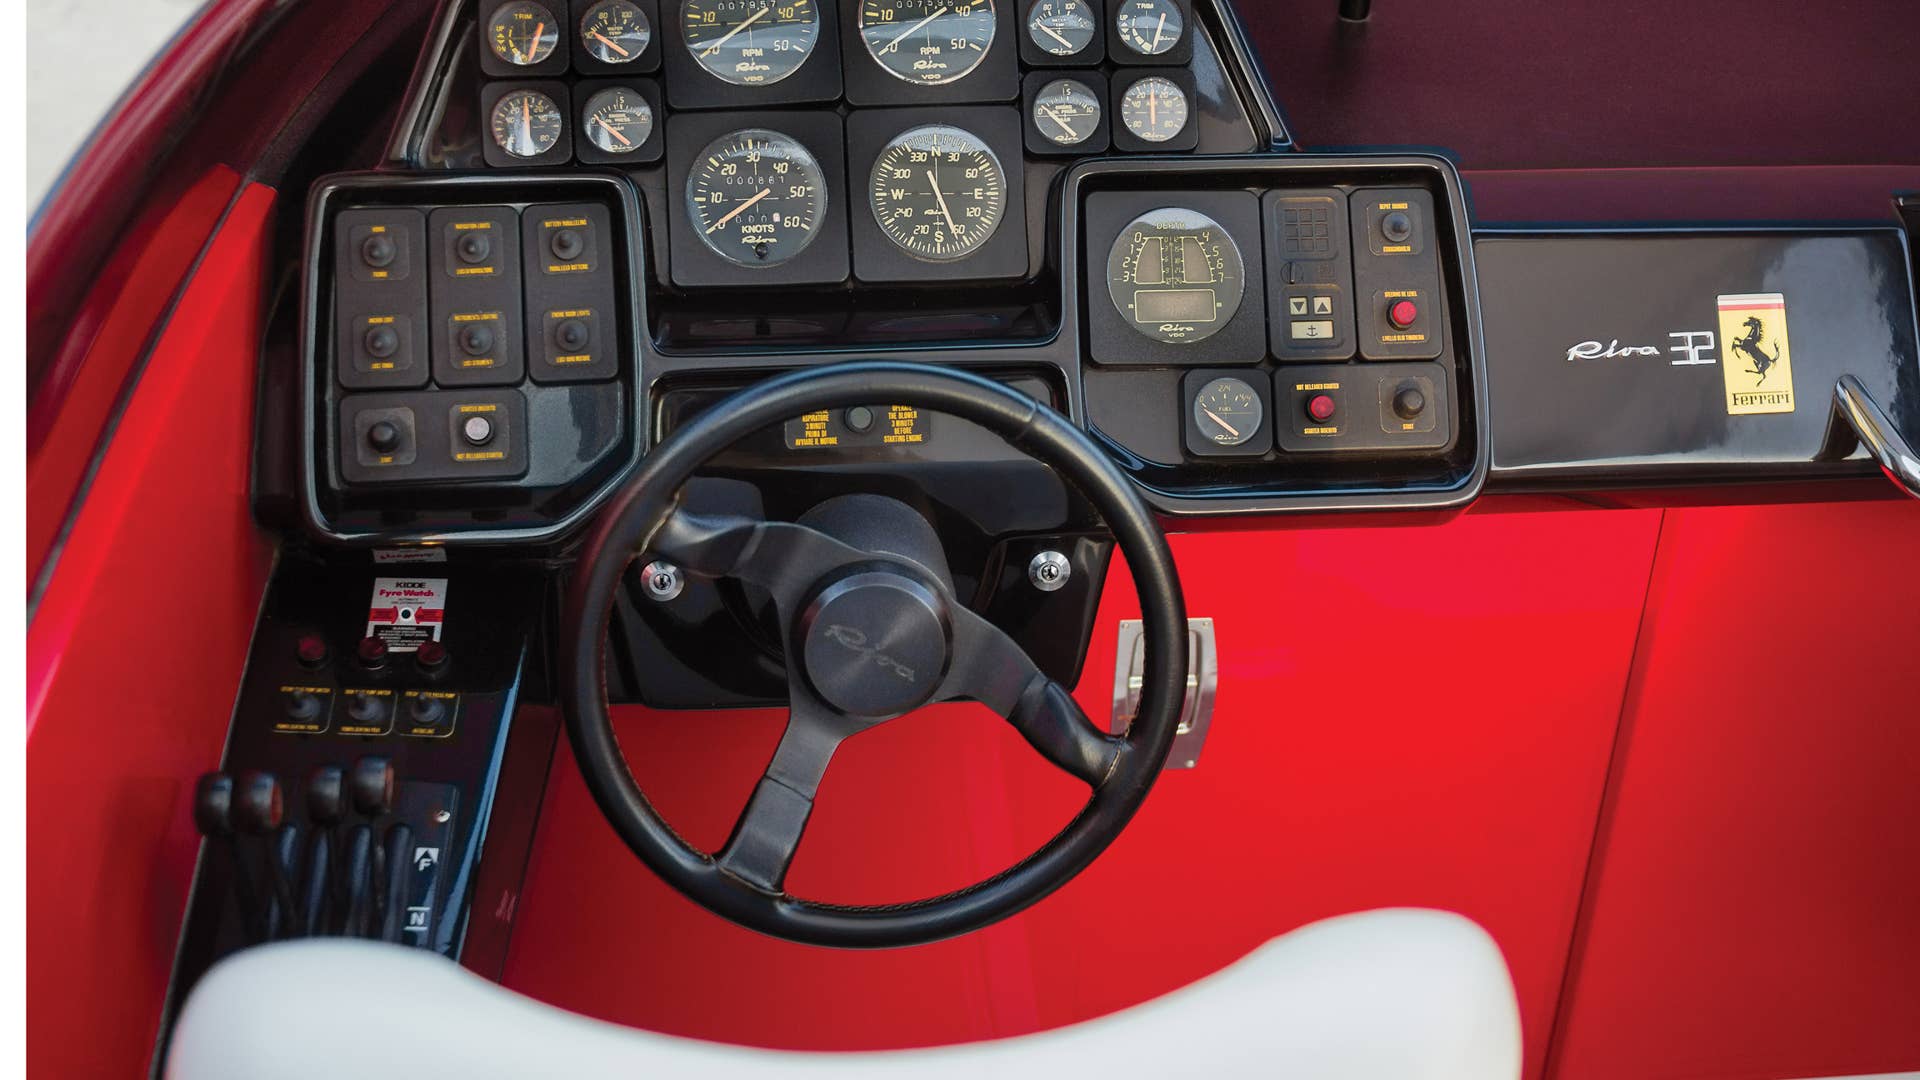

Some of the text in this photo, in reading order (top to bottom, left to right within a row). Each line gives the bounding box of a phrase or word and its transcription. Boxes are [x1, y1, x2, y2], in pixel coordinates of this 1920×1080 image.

[778, 8, 794, 19] 40
[881, 9, 893, 21] 10
[955, 6, 971, 17] 40
[703, 12, 716, 23] 10
[774, 40, 789, 51] 50
[951, 38, 966, 49] 50
[742, 49, 763, 57] RPM
[920, 47, 941, 55] RPM
[619, 96, 625, 104] 5
[746, 151, 760, 162] 30
[931, 146, 941, 157] N
[948, 152, 960, 162] 30
[910, 152, 927, 163] 330
[721, 164, 736, 175] 20
[773, 162, 788, 174] 40
[893, 168, 911, 179] 300
[965, 168, 978, 179] 60
[710, 192, 722, 203] 10
[790, 186, 805, 198] 50
[890, 189, 905, 200] W
[974, 188, 983, 200] E
[894, 207, 913, 218] 240
[966, 207, 981, 218] 120
[783, 216, 800, 227] 60
[741, 224, 775, 233] KNOTS
[913, 224, 929, 235] 210
[935, 231, 944, 243] S
[1134, 232, 1142, 243] 0
[1203, 232, 1210, 242] 4
[1130, 244, 1134, 254] 1
[1213, 246, 1219, 257] 5
[1123, 257, 1131, 268] 2
[1217, 258, 1224, 269] 6
[1123, 270, 1130, 282] 3
[1218, 272, 1224, 283] 7
[1159, 324, 1194, 332] Riva
[1566, 331, 1717, 366] Riva 32
[1732, 391, 1790, 406] Ferrari
[888, 412, 897, 420] THE
[894, 427, 912, 435] BEFORE
[379, 589, 434, 597] Fyre Watch
[824, 624, 915, 682] Riva
[419, 858, 433, 871] F
[410, 911, 425, 926] N
